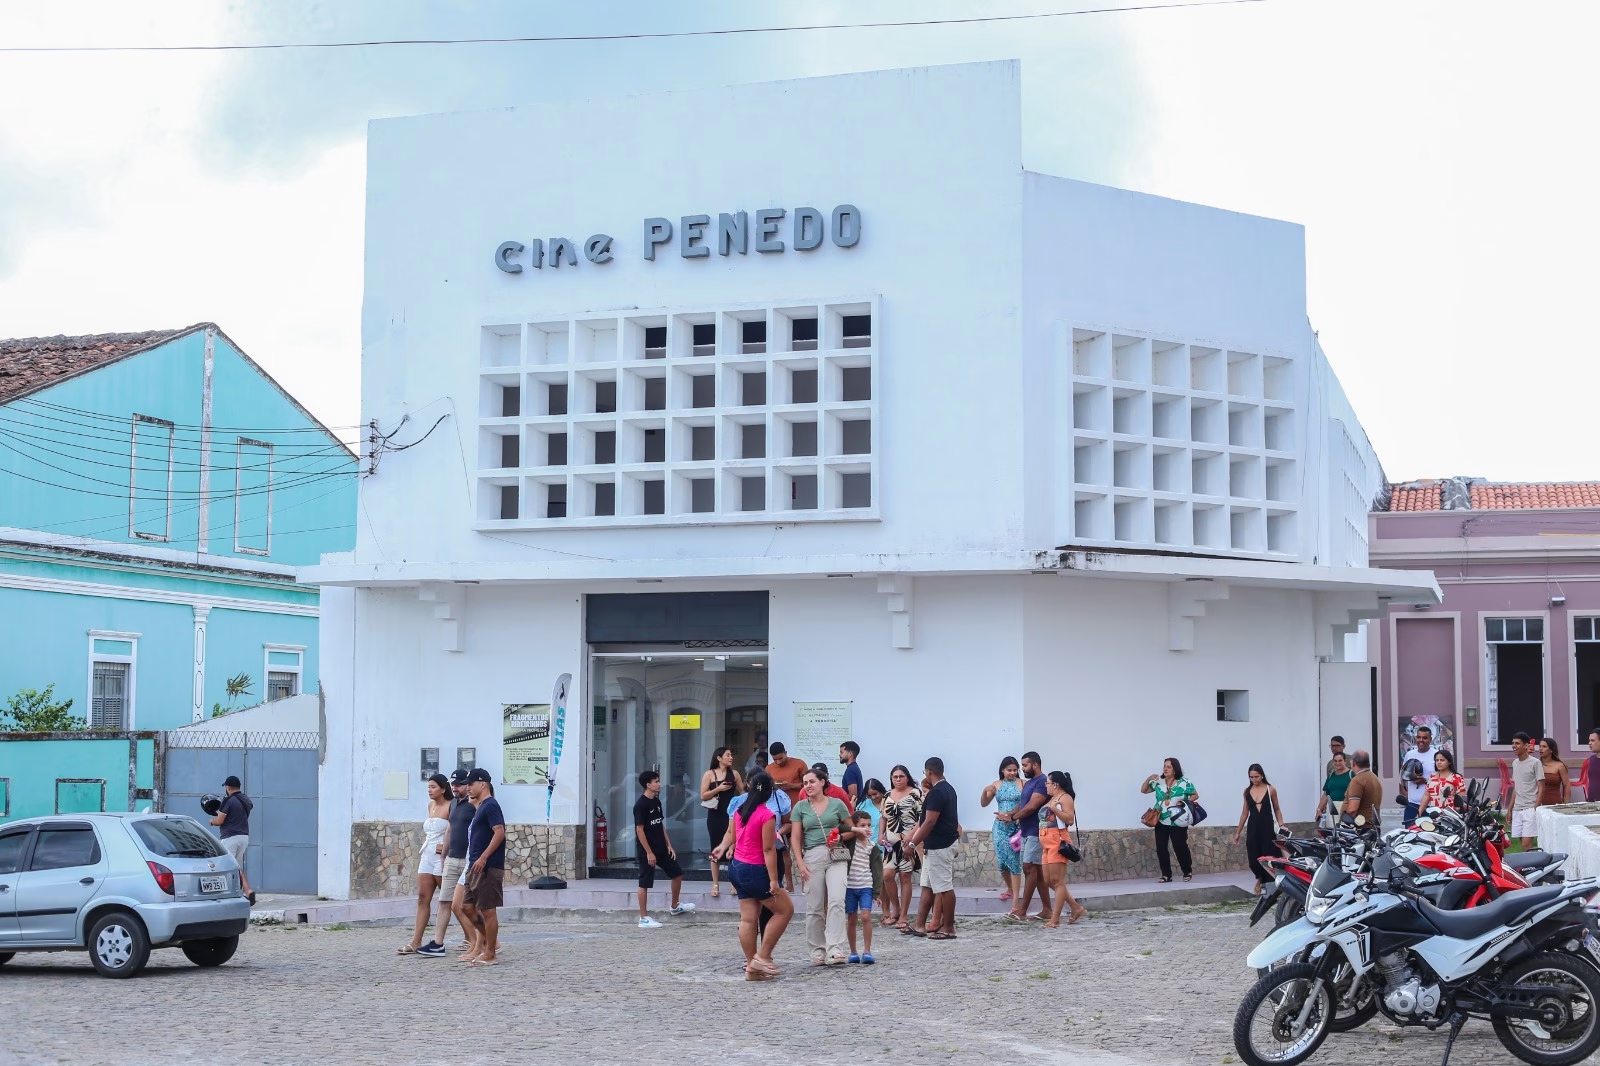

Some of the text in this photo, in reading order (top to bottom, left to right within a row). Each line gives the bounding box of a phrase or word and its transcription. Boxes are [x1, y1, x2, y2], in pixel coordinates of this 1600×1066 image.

[643, 204, 862, 261] PENEDO
[511, 720, 548, 728] RIBEIRINHOS
[1490, 931, 1513, 945] HONDA
